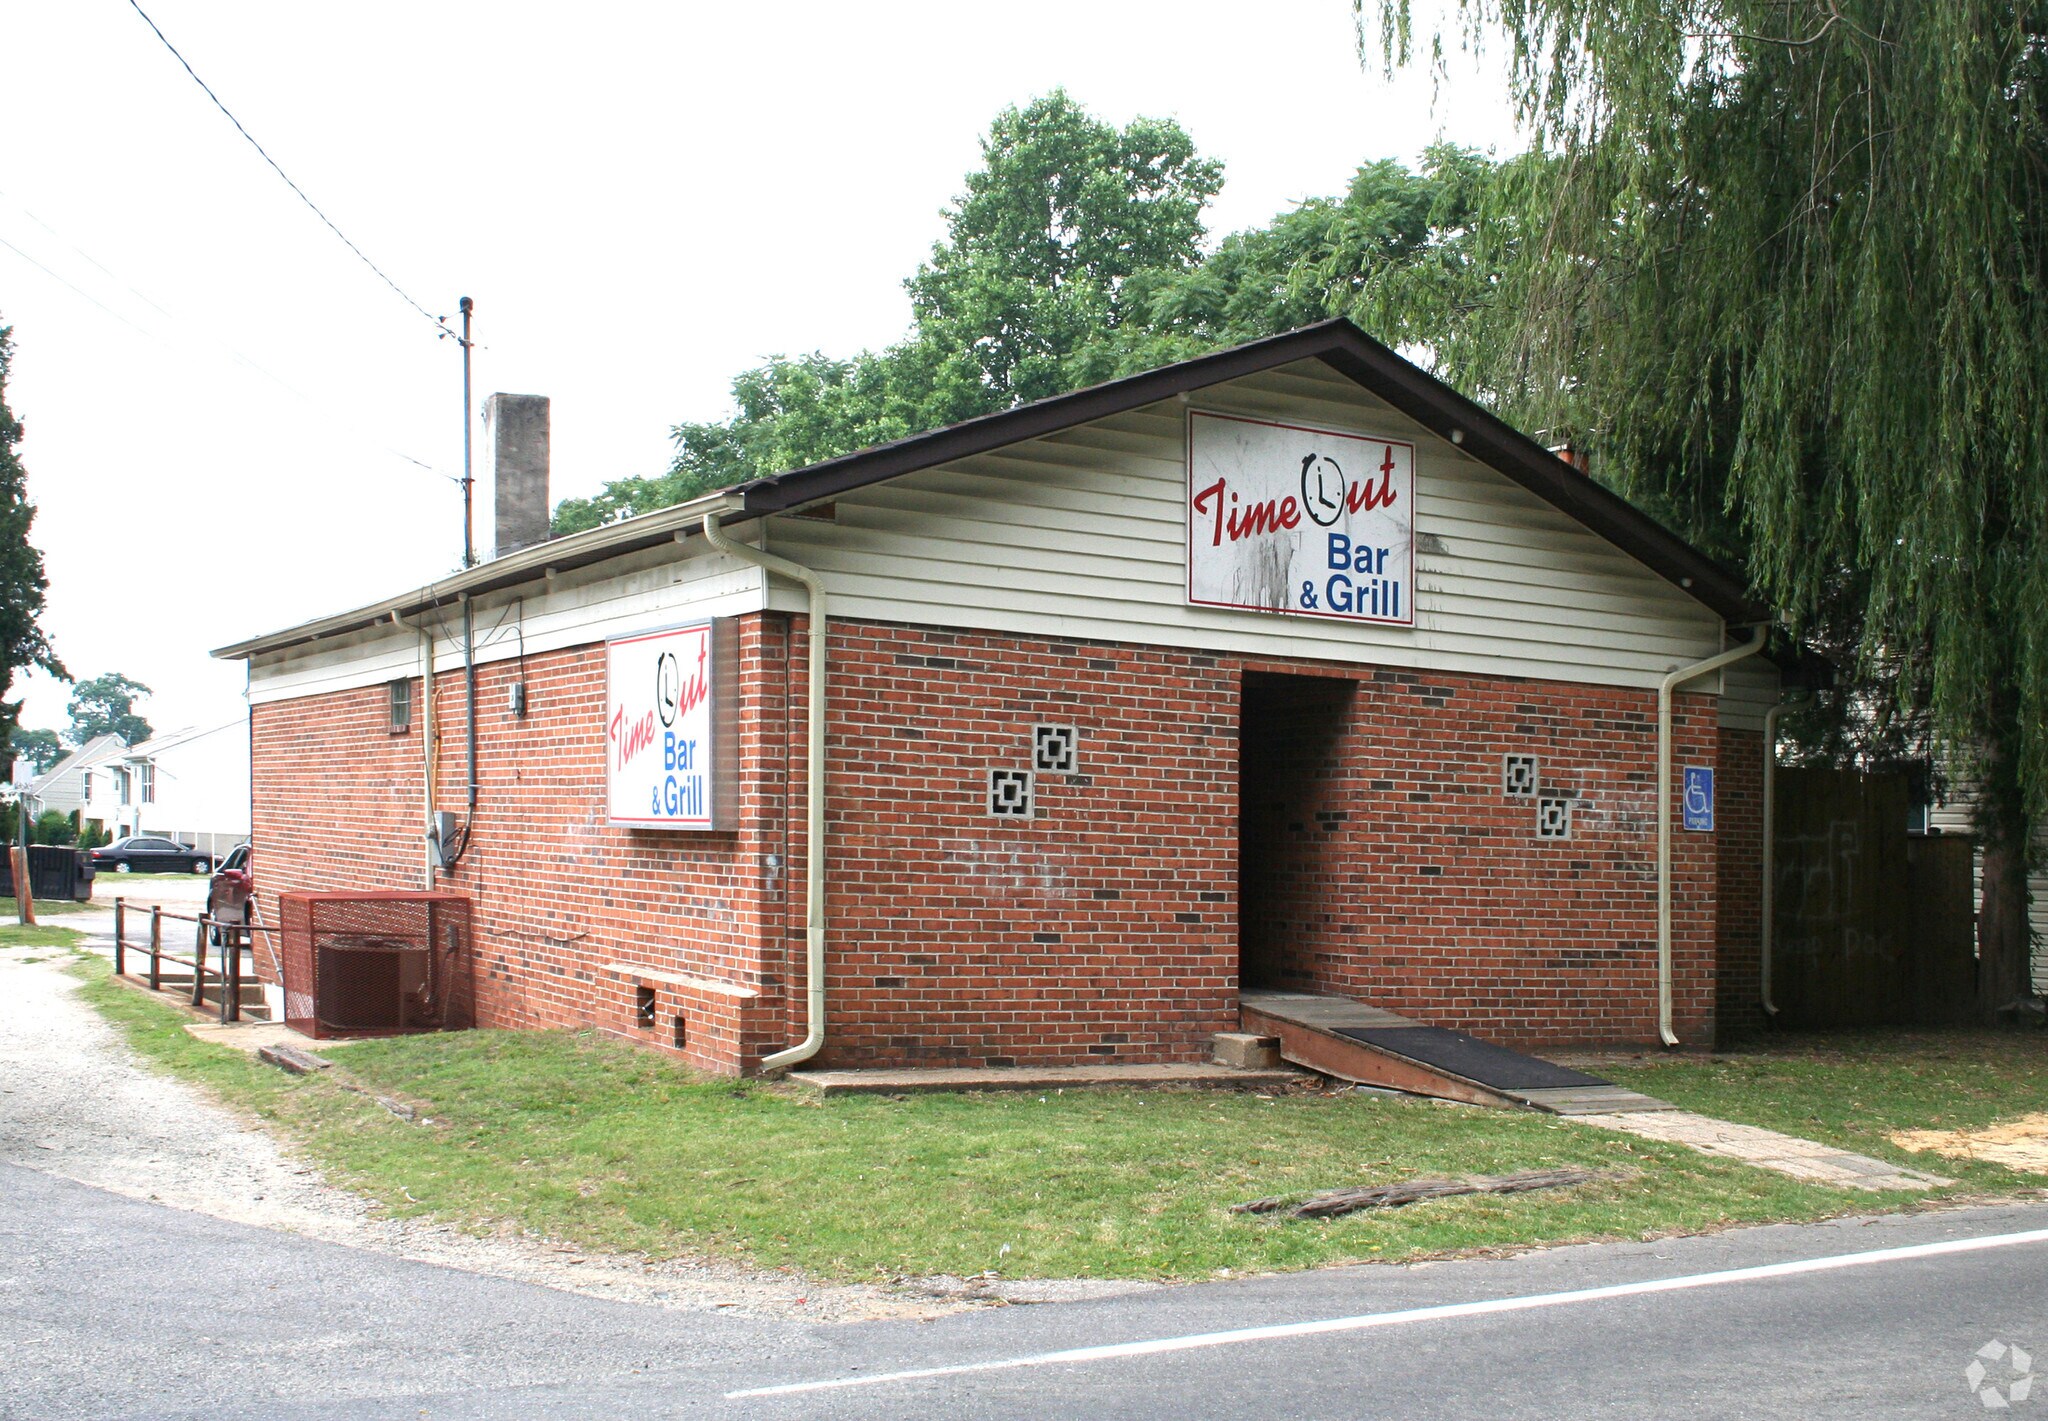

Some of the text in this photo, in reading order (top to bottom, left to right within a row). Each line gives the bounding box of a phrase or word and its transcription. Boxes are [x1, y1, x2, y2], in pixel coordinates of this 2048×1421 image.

[1194, 477, 1301, 546] Time
[1328, 532, 1389, 575] Bar
[1300, 573, 1399, 617] & Grill
[610, 703, 655, 772] Time
[664, 731, 696, 771] Bar
[652, 774, 703, 816] & Grill
